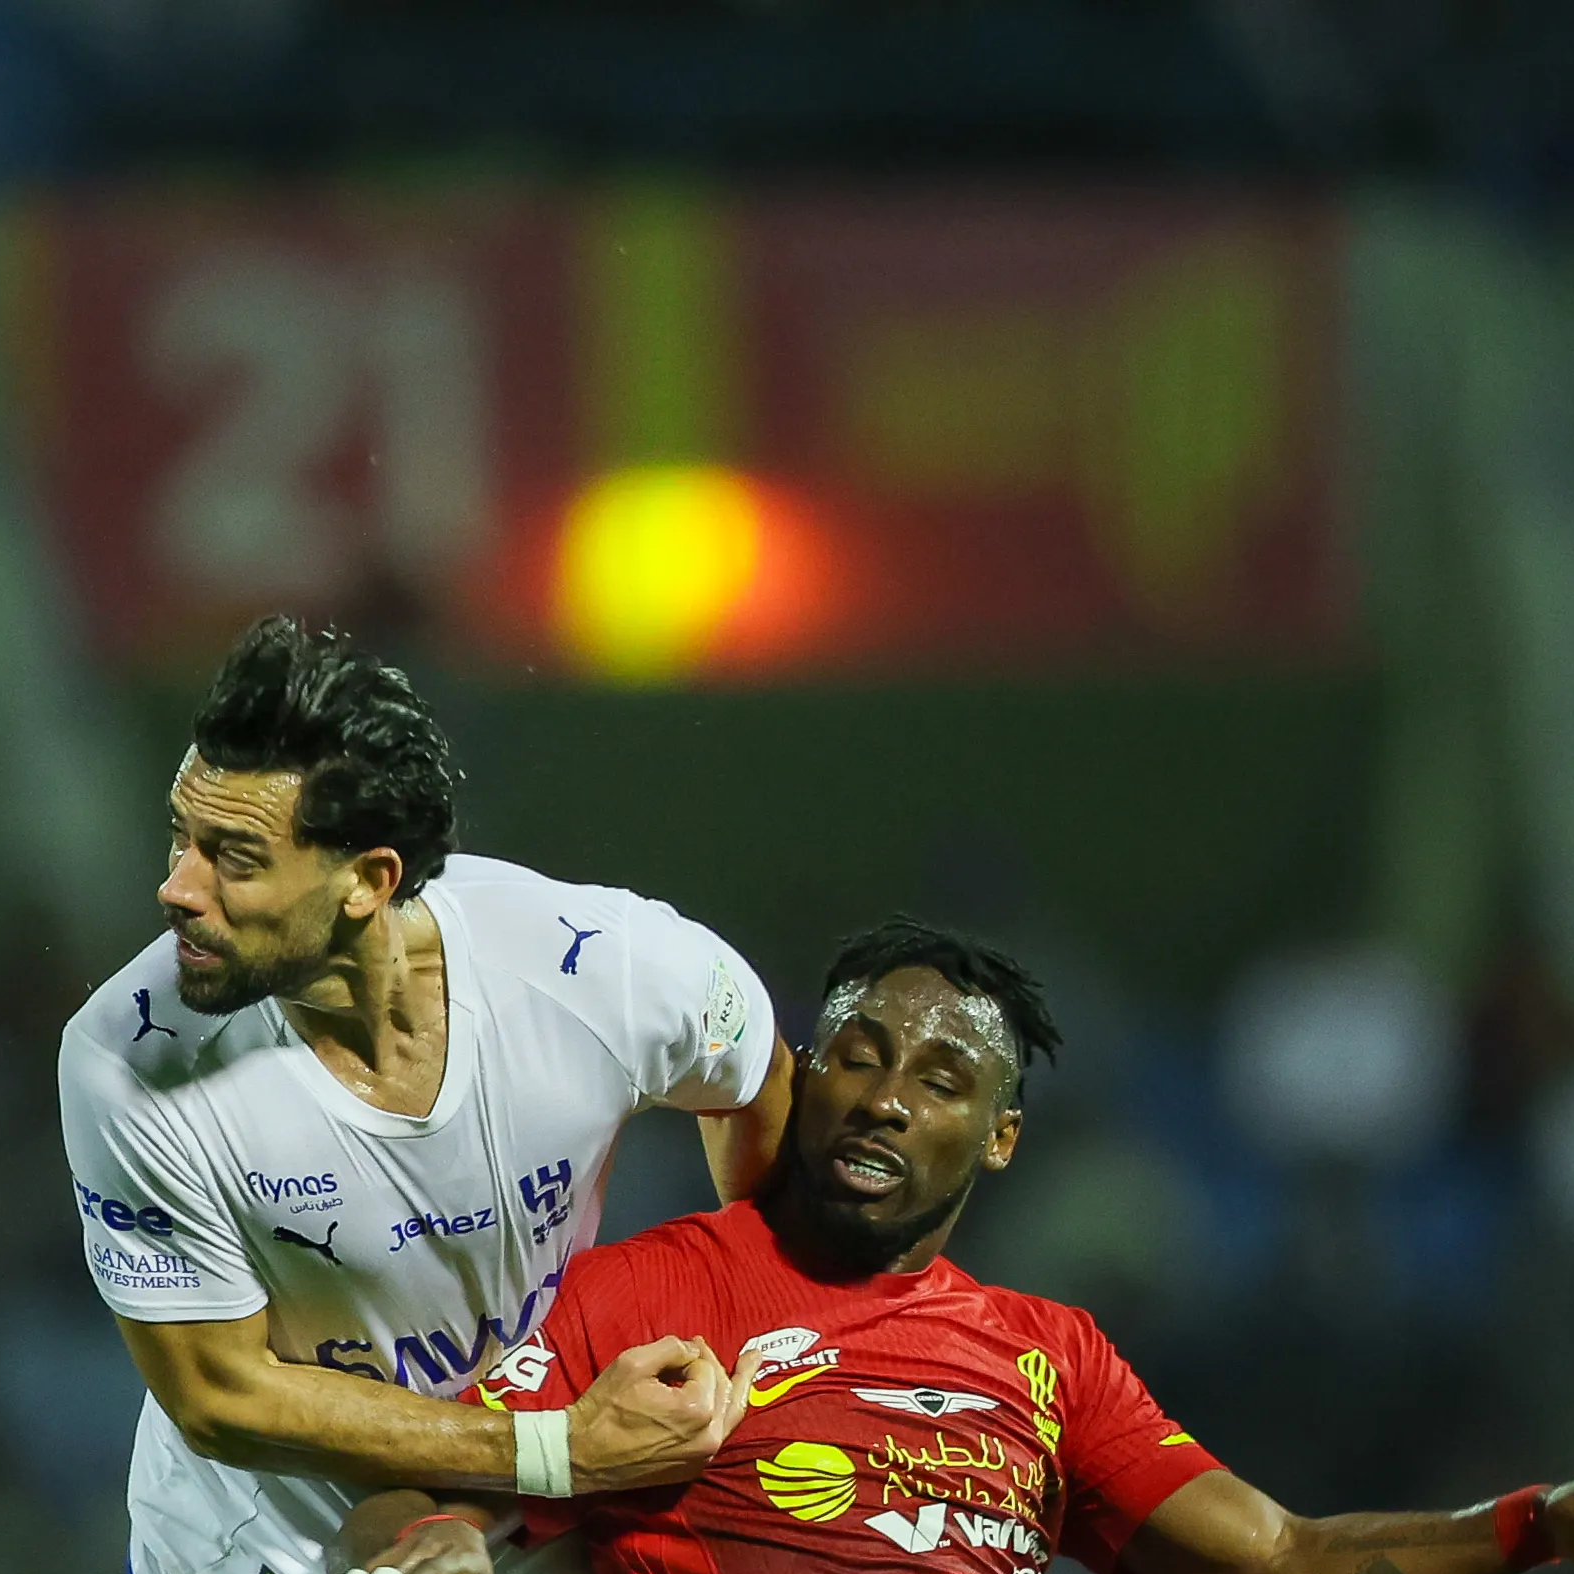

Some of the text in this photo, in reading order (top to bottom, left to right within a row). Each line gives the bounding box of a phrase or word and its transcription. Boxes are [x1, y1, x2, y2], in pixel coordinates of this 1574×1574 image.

[247, 1171, 339, 1204] flynas
[75, 1179, 174, 1237] ree
[93, 1242, 197, 1275] SANABIL
[94, 1264, 201, 1289] INVESTMENTS
[867, 1431, 1006, 1473] للطيران
